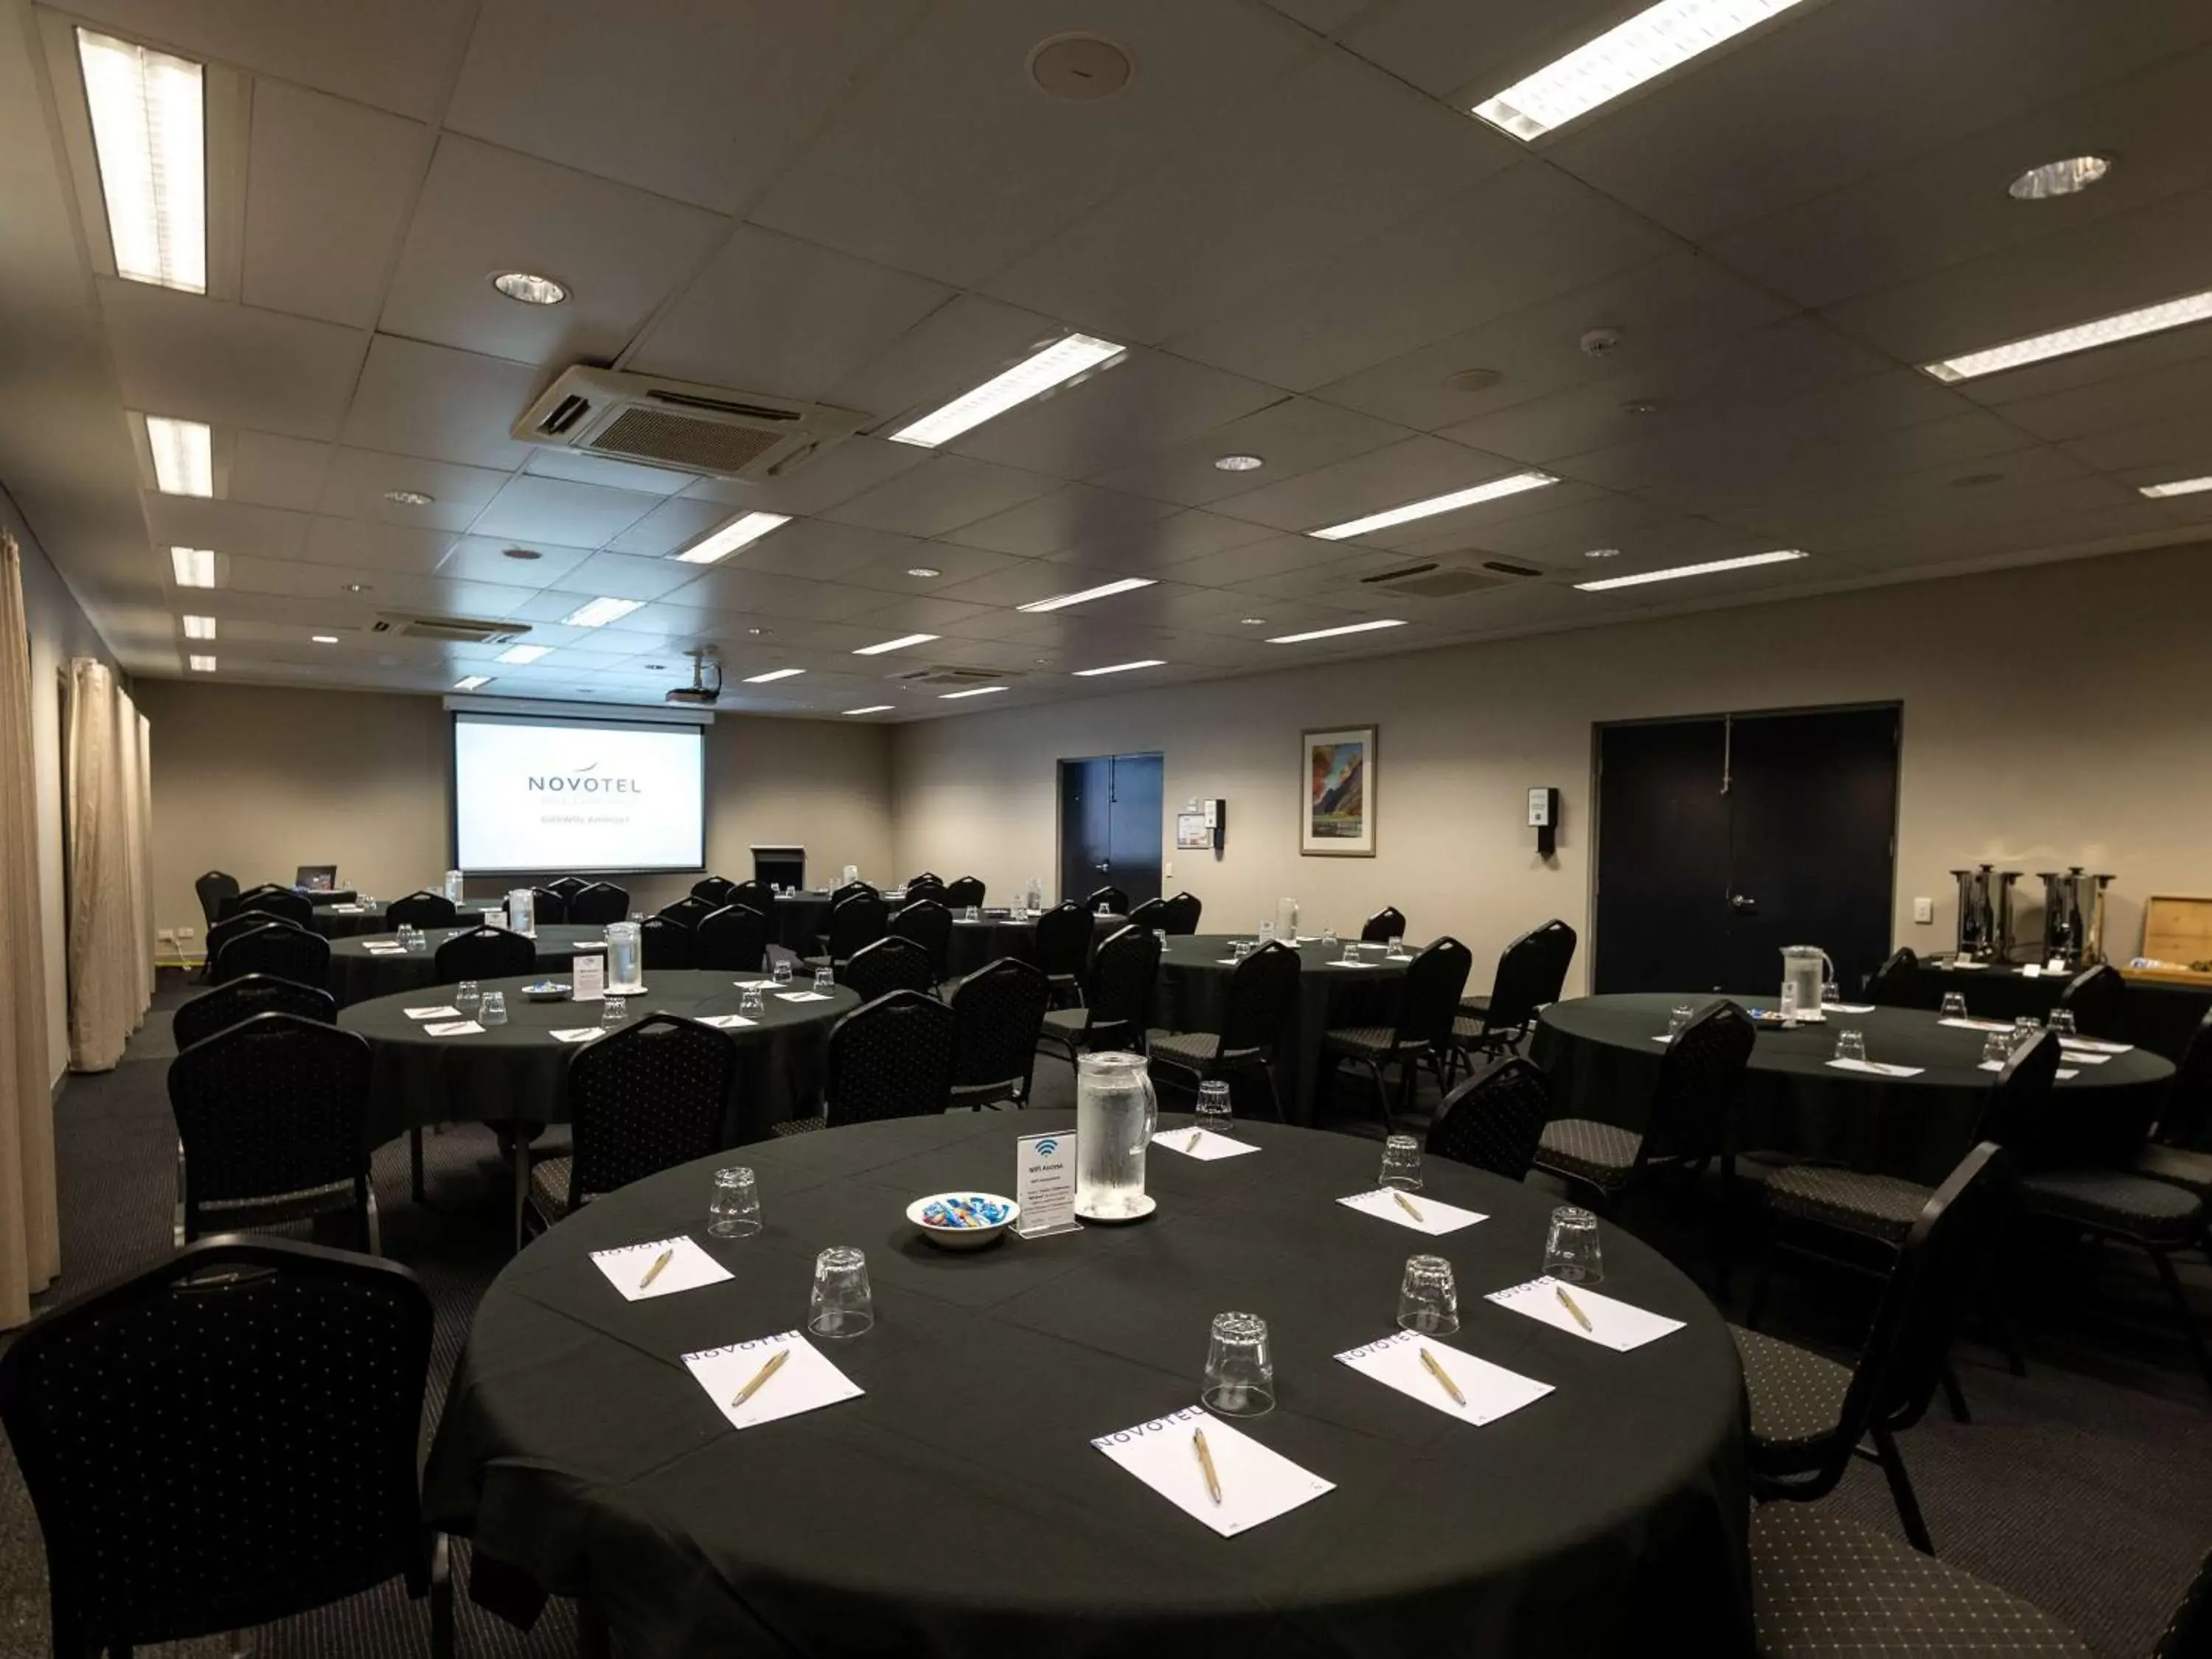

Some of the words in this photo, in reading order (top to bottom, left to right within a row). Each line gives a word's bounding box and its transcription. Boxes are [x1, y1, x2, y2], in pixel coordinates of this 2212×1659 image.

[528, 776, 642, 793] NOVOTEL
[684, 1330, 801, 1361] NOVOTEL
[1093, 1407, 1204, 1449] NOVOTEL
